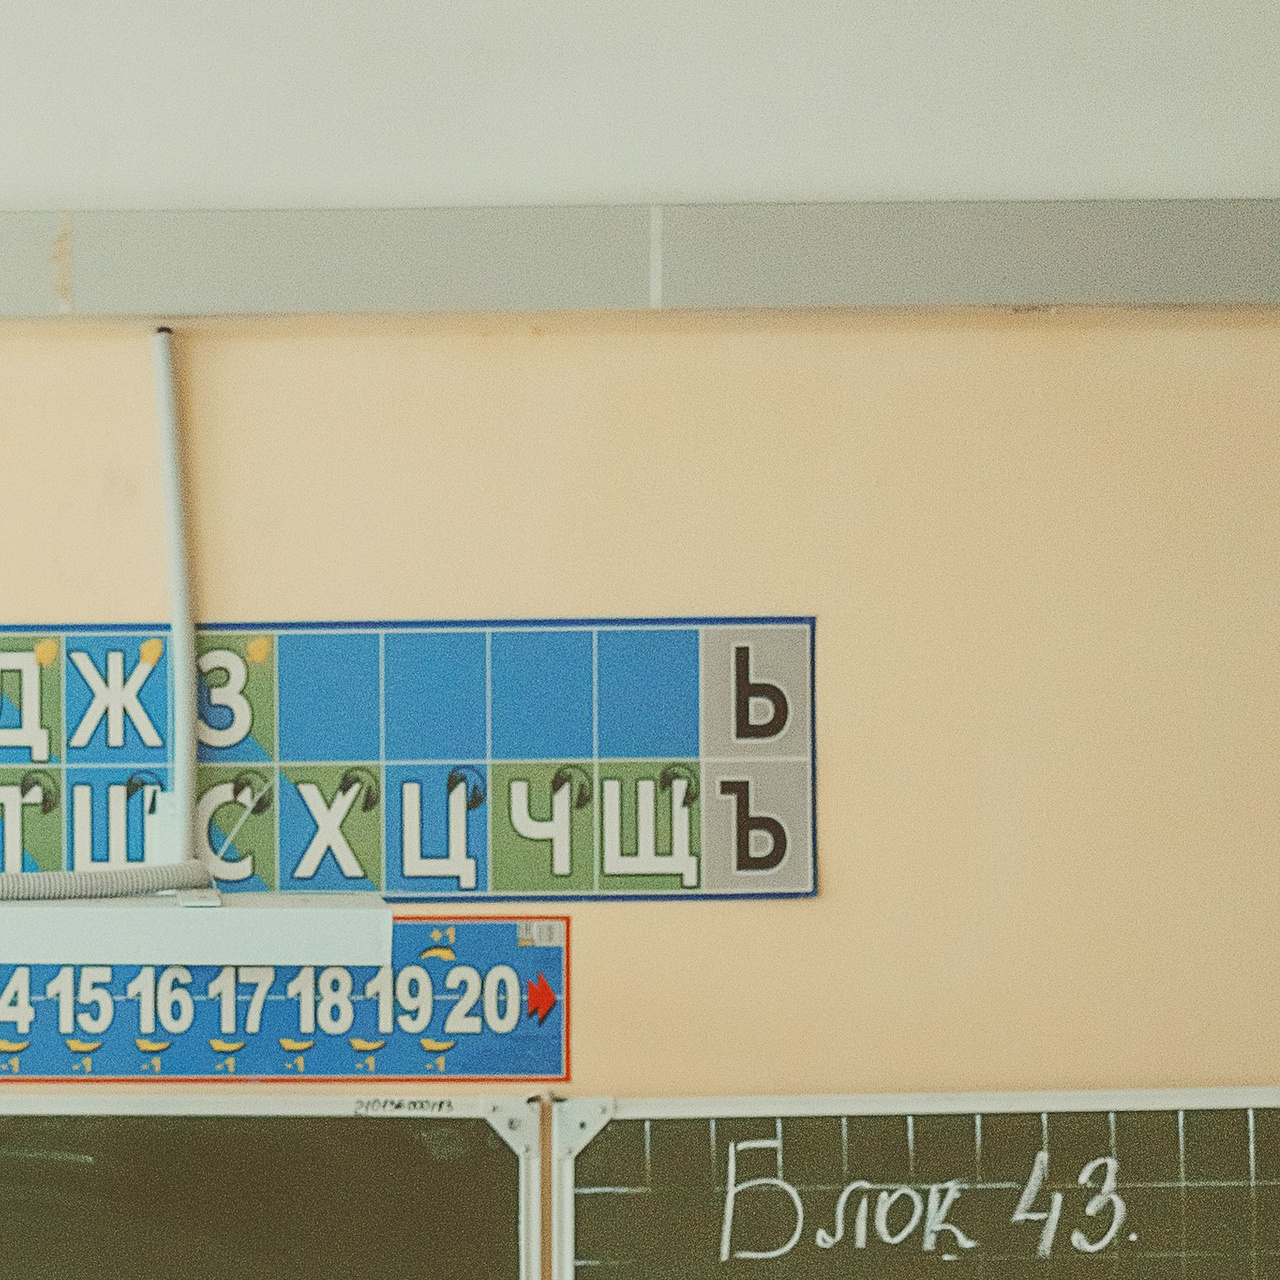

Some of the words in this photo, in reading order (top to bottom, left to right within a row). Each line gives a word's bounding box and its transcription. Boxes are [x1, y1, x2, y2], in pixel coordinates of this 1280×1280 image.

[69, 650, 163, 748] Ж
[199, 648, 252, 747] З
[734, 645, 789, 740] Ь
[206, 783, 256, 881] С
[293, 782, 364, 878] Х
[402, 780, 476, 889] Ц
[510, 780, 572, 875] Ч
[602, 779, 697, 887] Щ
[720, 780, 786, 871] Ъ
[45, 966, 114, 1034] 15
[127, 966, 194, 1034] 16
[207, 966, 275, 1034] 17
[286, 966, 354, 1034] 18
[364, 966, 433, 1034] 19
[444, 965, 521, 1034] 20
[720, 1142, 978, 1258] Блок
[1012, 1150, 1138, 1256] 43.
